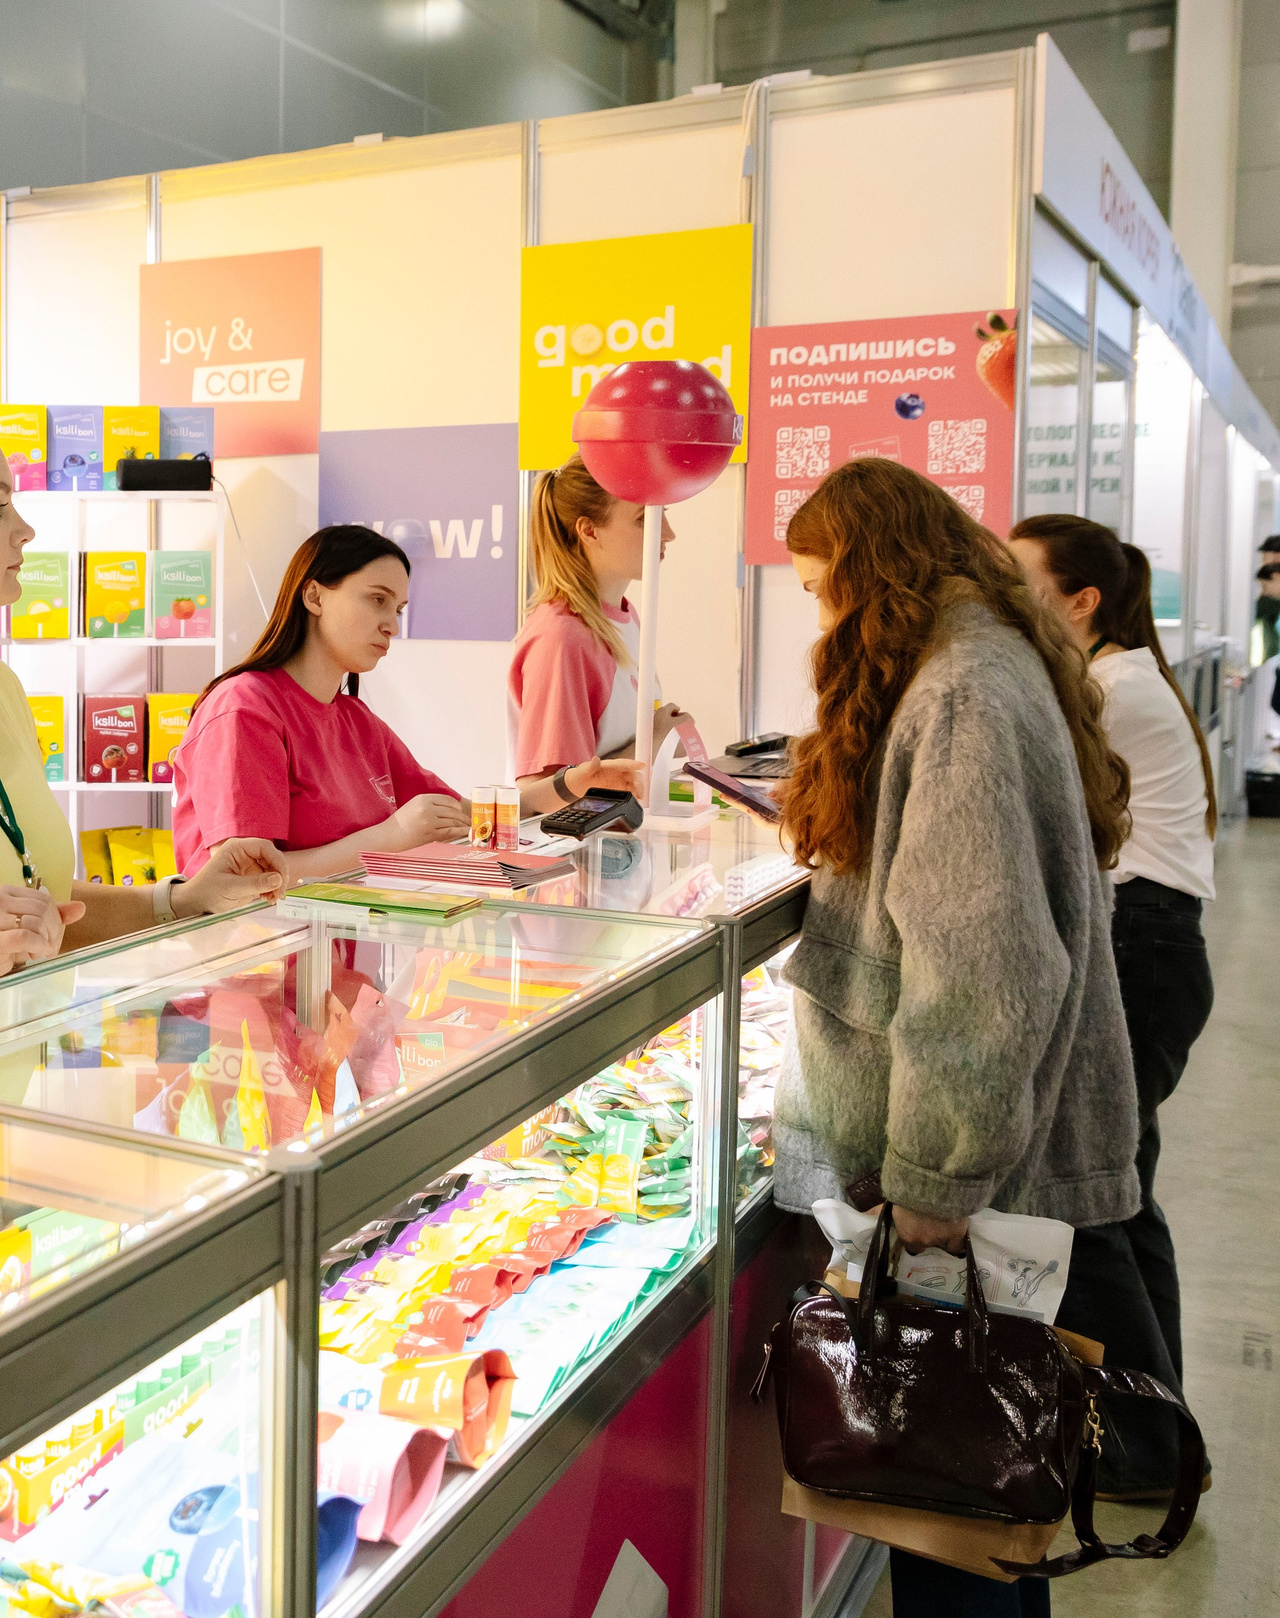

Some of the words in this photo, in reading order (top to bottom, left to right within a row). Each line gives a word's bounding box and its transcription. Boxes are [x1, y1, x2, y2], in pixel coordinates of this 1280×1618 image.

[159, 320, 216, 364] joy
[227, 317, 253, 351] &
[769, 337, 956, 366] ПОДПИШИСЬ
[204, 365, 290, 397] care
[571, 344, 732, 397] md
[770, 376, 782, 389] И
[787, 371, 858, 388] ПОЛУЧИ
[863, 366, 956, 384] ПОДАРОК
[769, 393, 793, 407] НА
[797, 389, 869, 407] СТЕНДЕ
